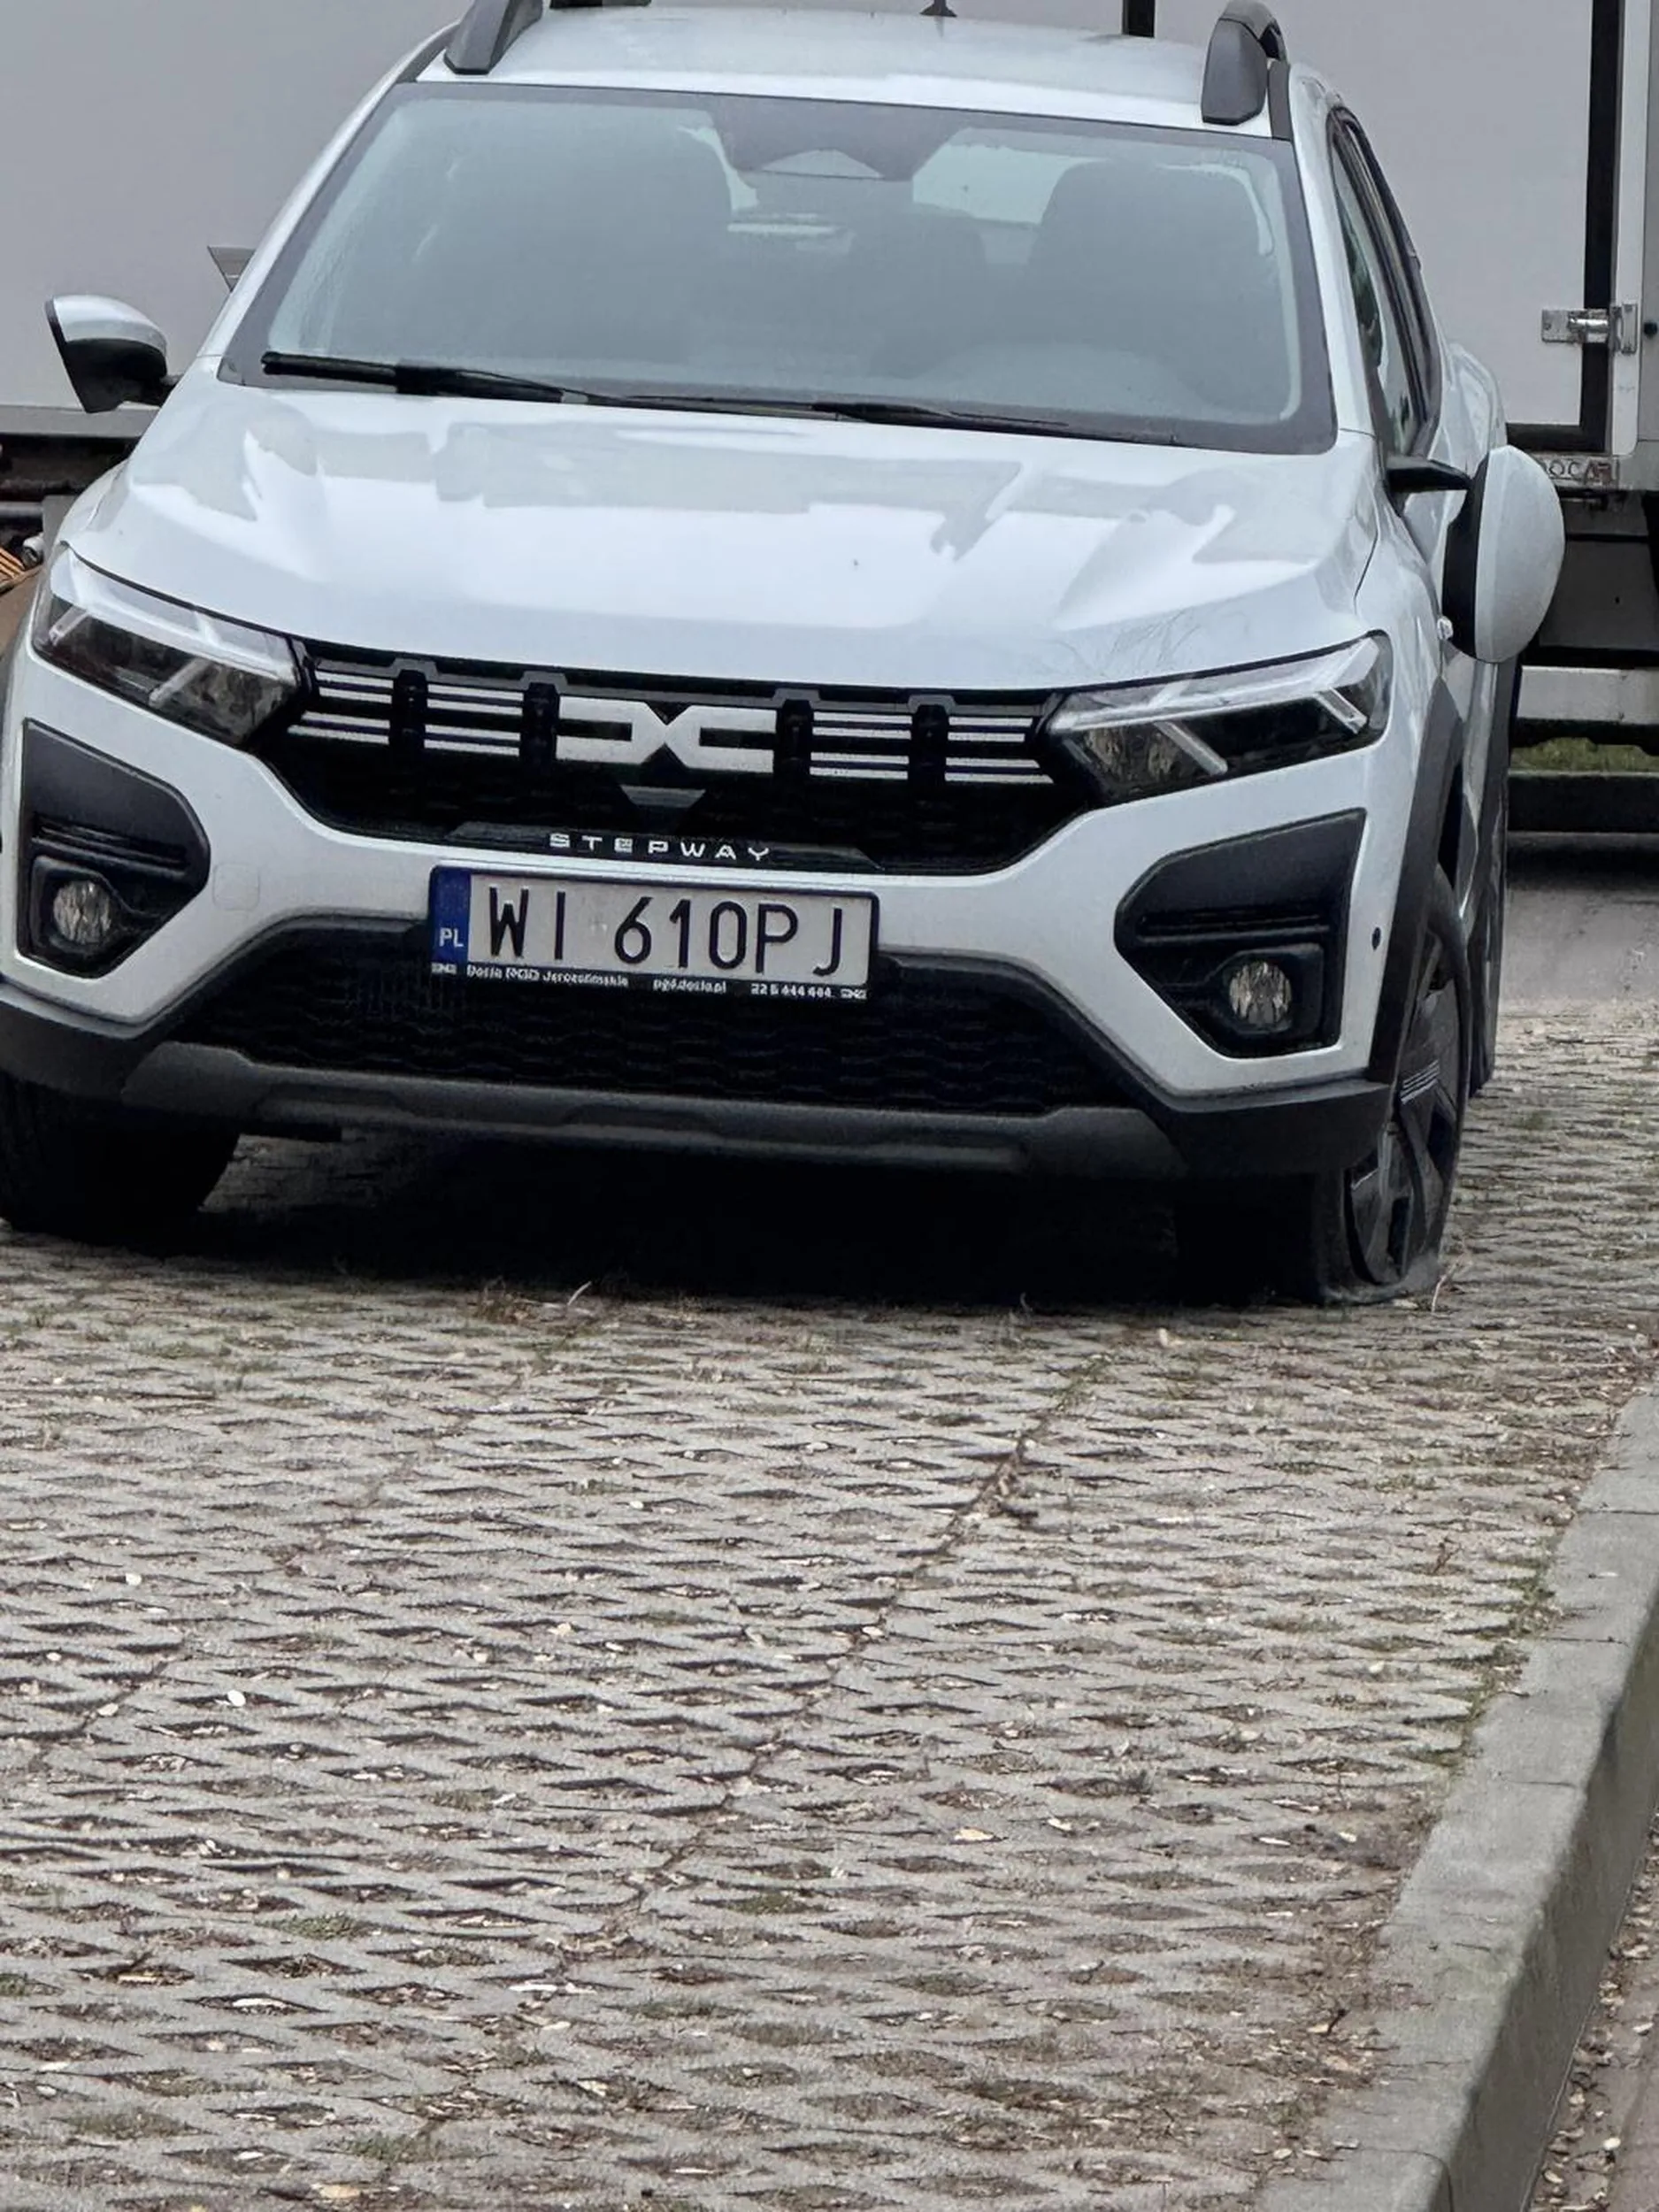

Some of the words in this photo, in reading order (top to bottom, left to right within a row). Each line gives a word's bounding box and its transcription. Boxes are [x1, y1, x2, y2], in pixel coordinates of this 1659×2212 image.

[549, 833, 769, 861] STEPWAY
[439, 928, 465, 948] PL
[489, 887, 566, 960] WI
[614, 896, 843, 978] 610PJ
